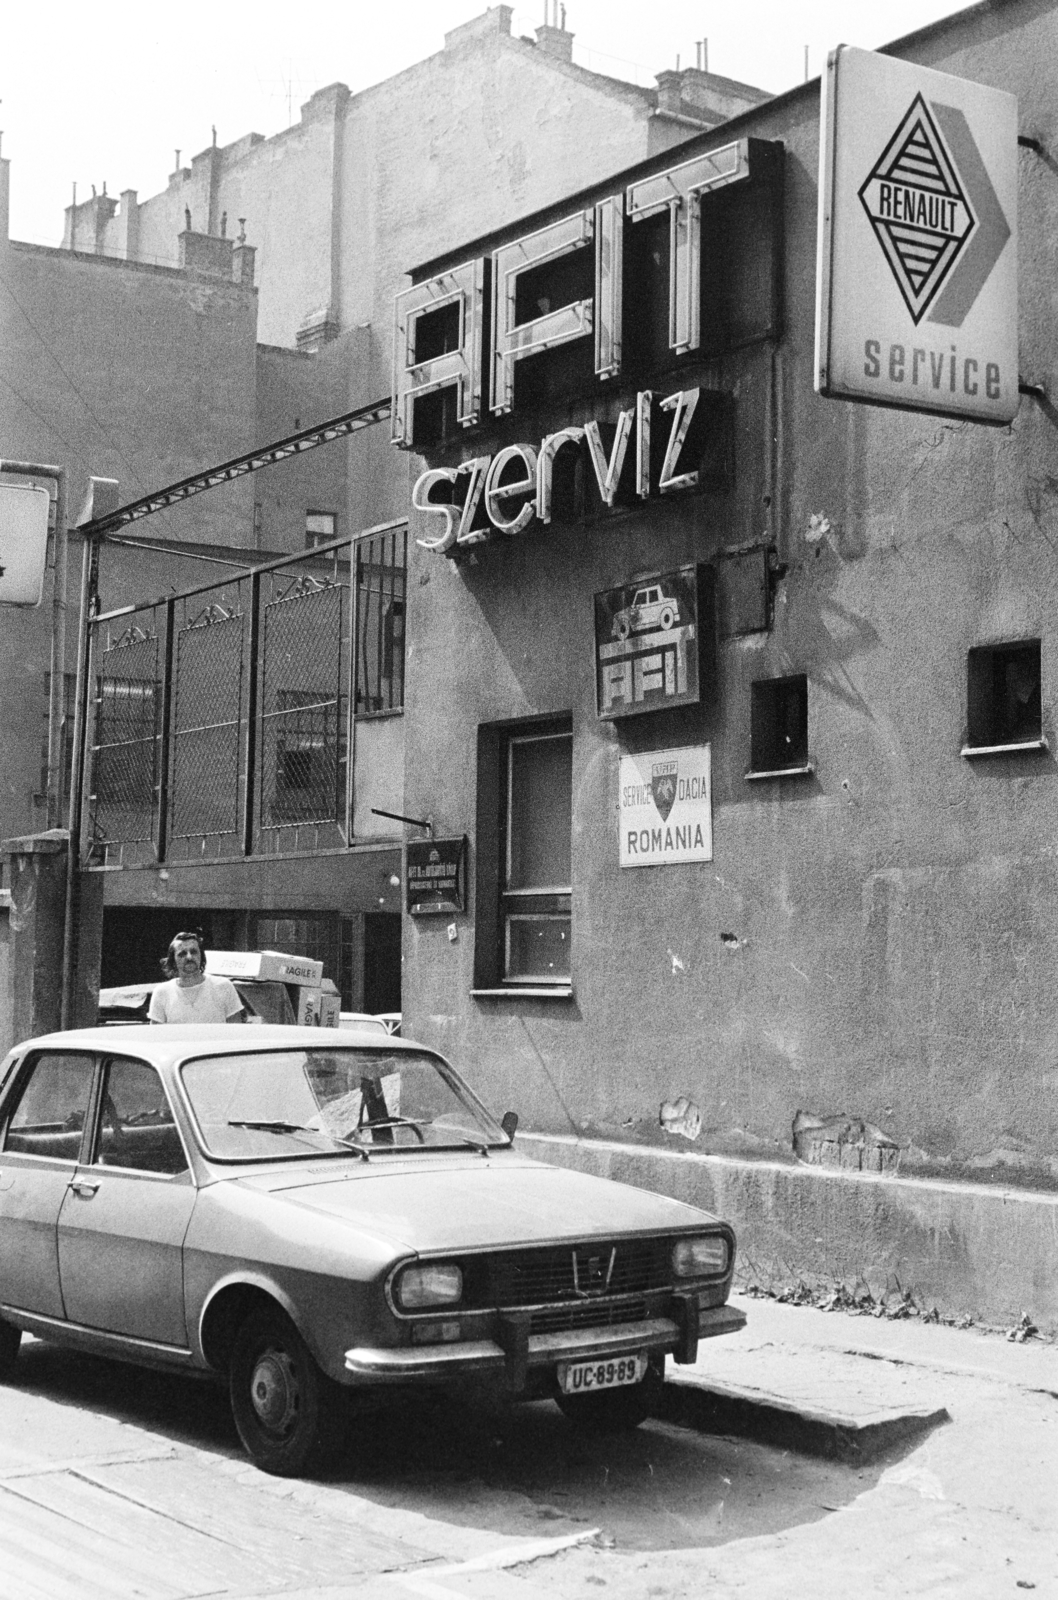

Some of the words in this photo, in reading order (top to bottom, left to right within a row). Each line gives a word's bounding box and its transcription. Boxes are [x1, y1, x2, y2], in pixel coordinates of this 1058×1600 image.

[879, 183, 958, 233] RENAULT
[391, 138, 749, 446] AFIT
[623, 783, 651, 807] SERVICE
[679, 777, 706, 801] DACIA
[628, 824, 704, 854] ROMANIA
[285, 966, 312, 978] RAGILE
